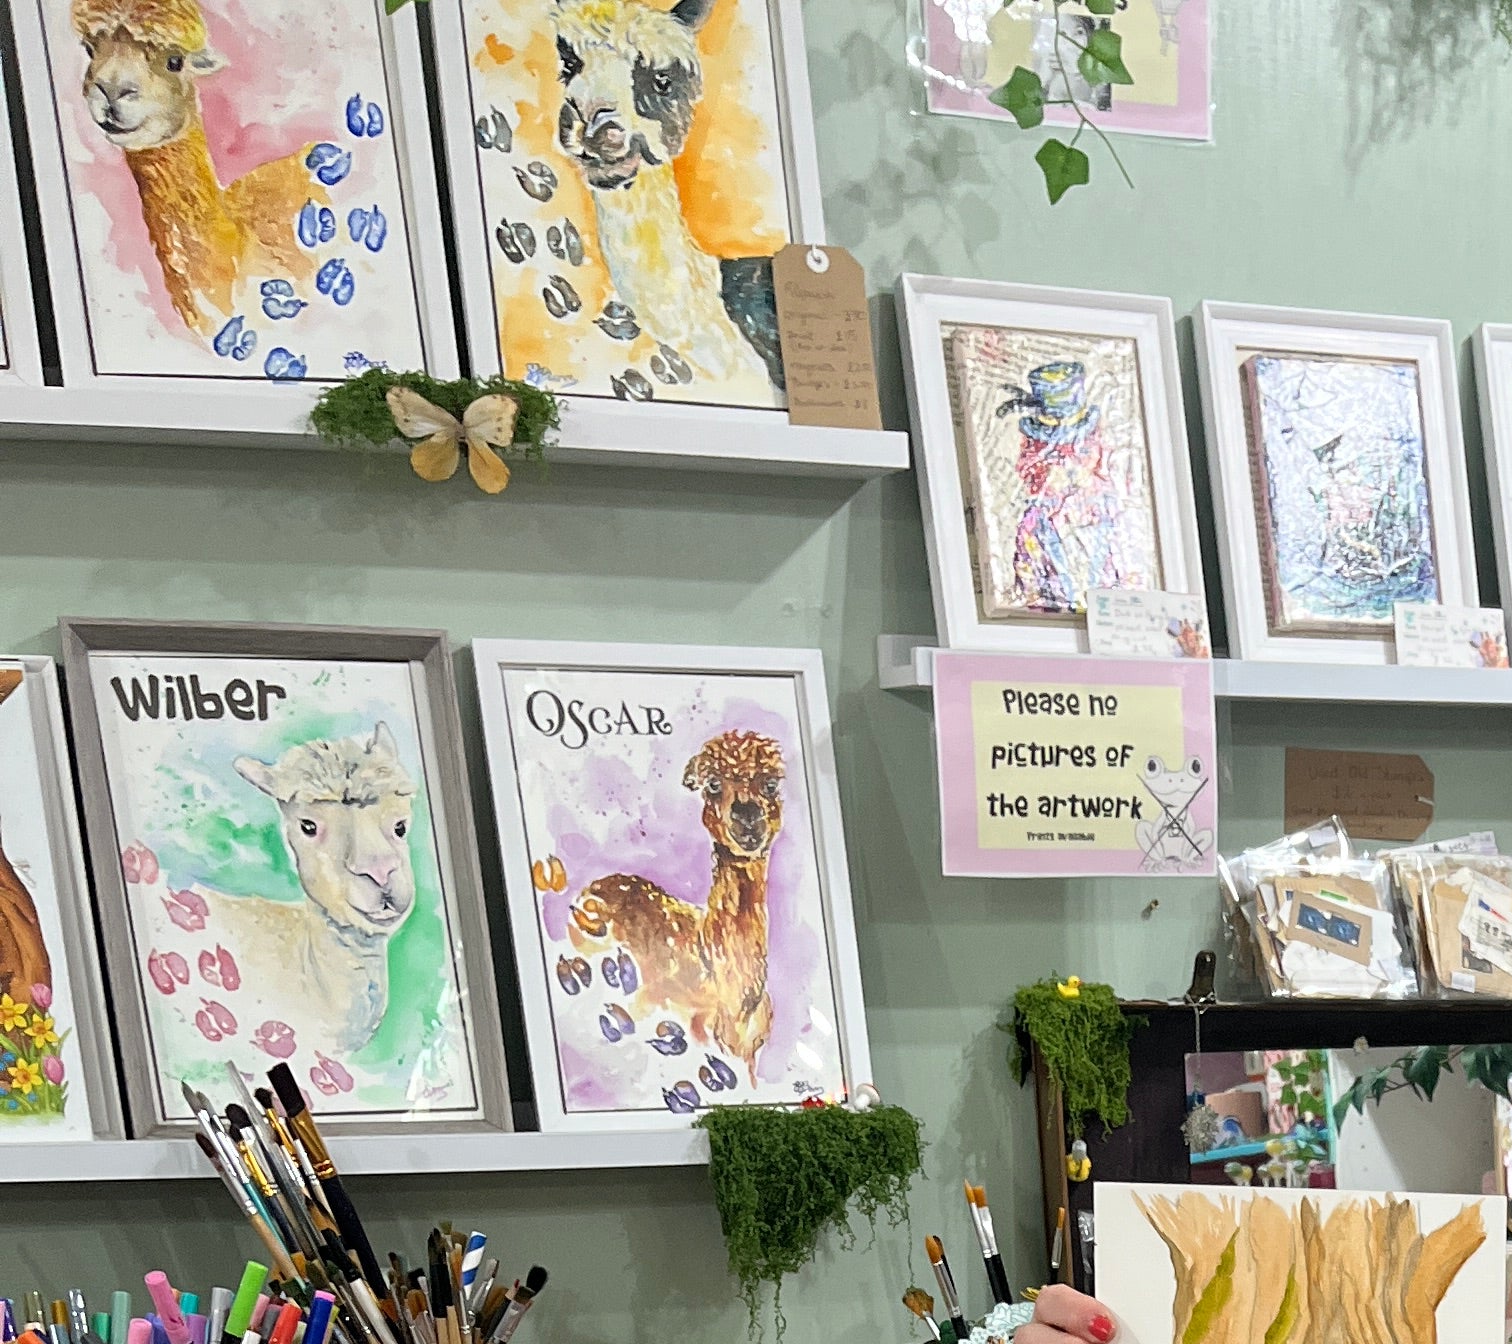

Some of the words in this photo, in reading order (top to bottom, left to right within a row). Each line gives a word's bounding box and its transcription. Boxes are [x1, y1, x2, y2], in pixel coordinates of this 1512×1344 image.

[110, 674, 287, 723] Wilber
[1002, 688, 1081, 716] Please
[1089, 694, 1119, 716] no
[525, 689, 674, 750] OSCAR
[991, 742, 1097, 770] pictures
[986, 793, 1029, 819] the
[1038, 795, 1143, 821] artwork
